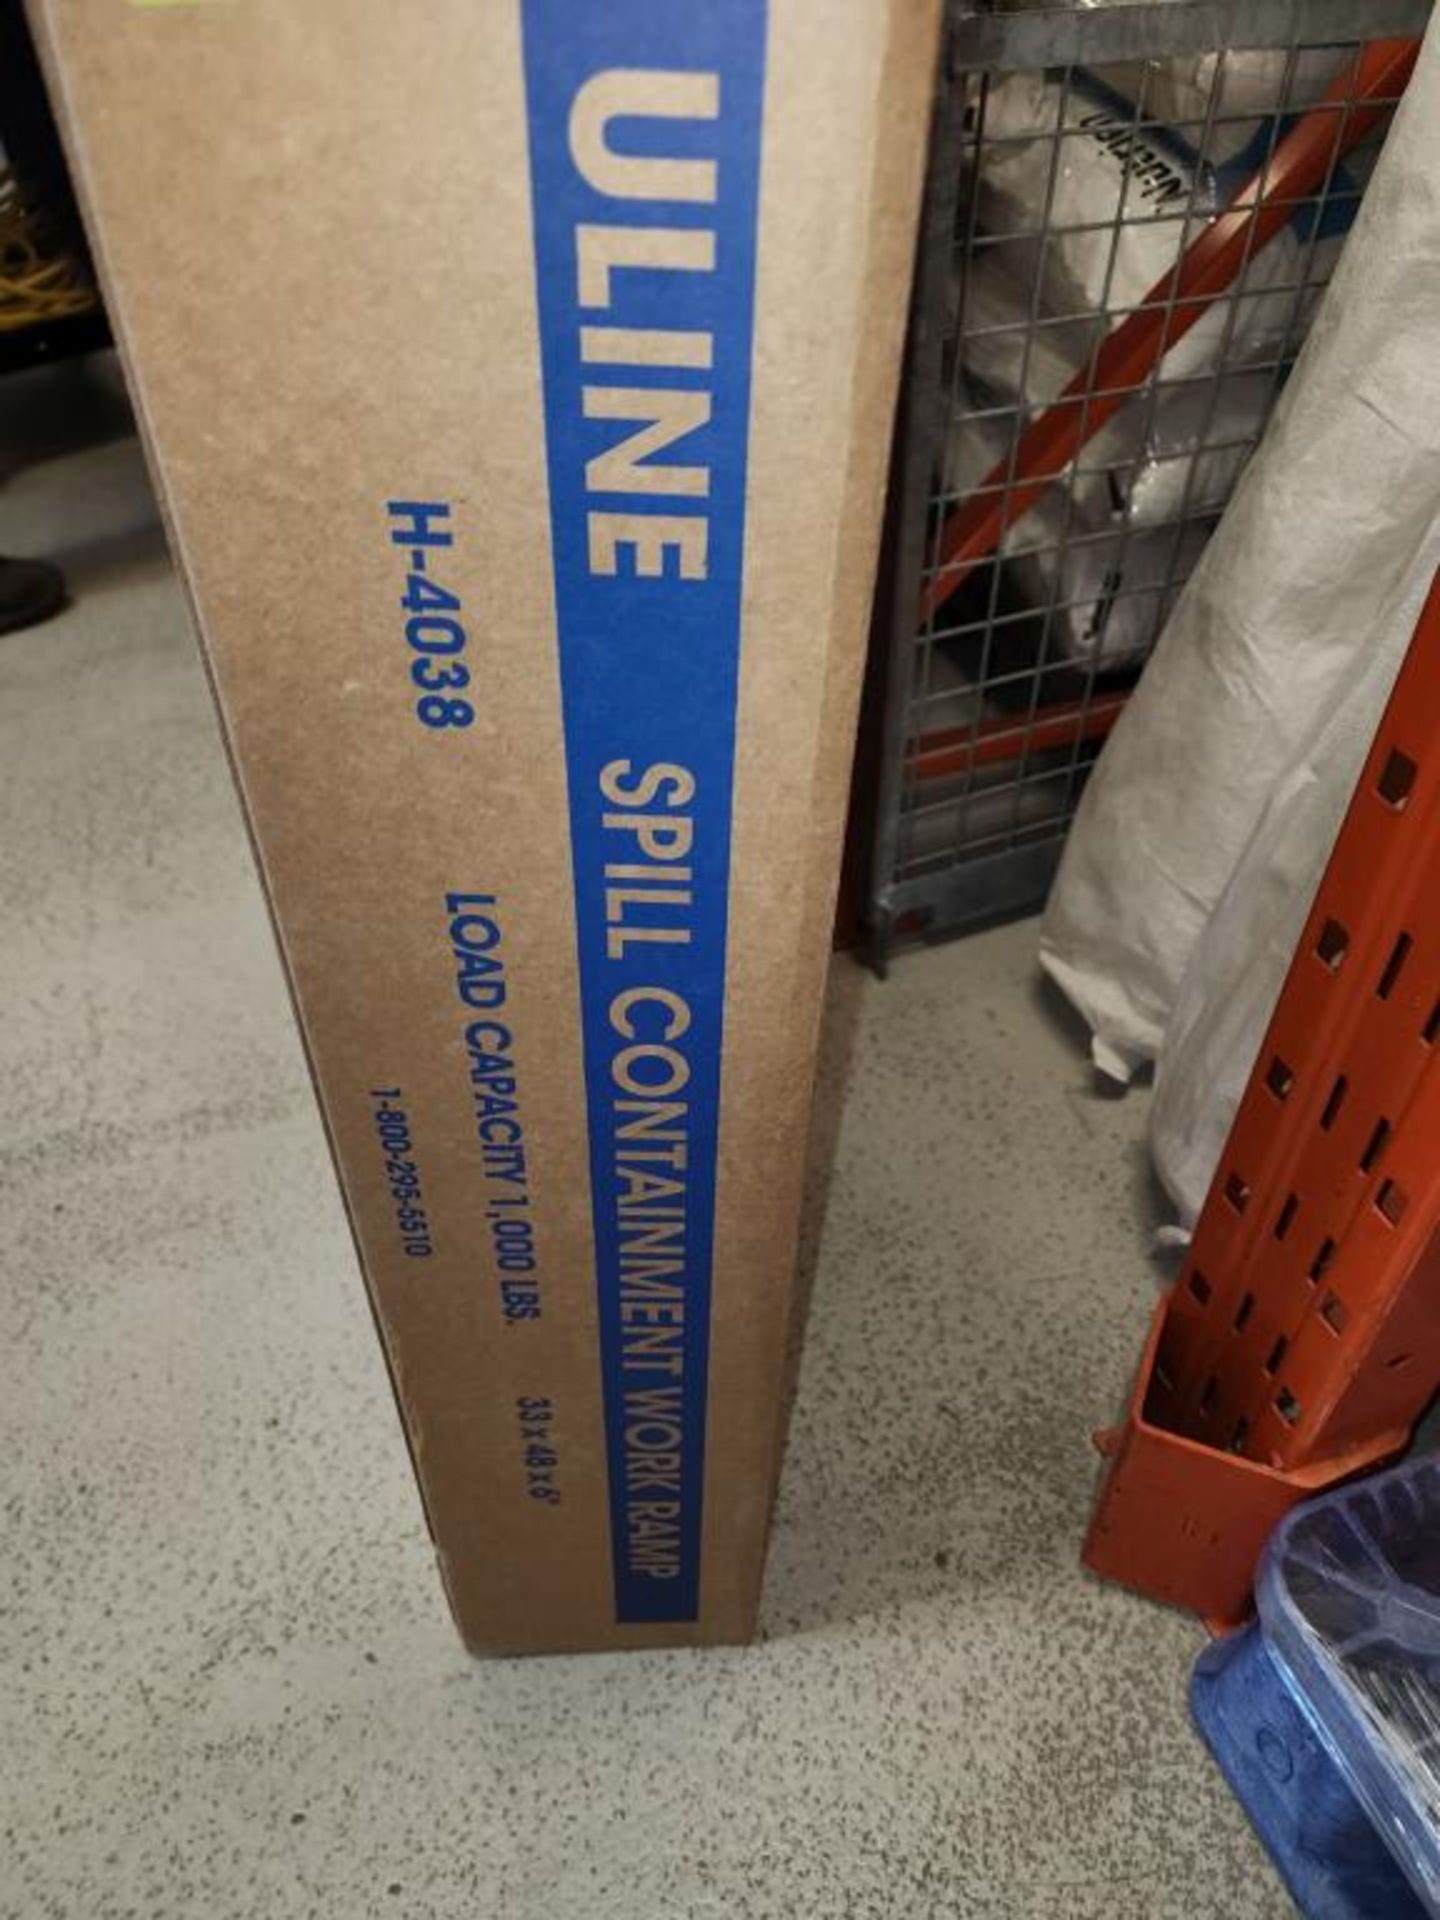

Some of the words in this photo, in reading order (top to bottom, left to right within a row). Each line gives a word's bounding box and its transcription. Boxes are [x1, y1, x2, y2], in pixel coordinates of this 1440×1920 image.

[567, 67, 719, 580] ULINE
[387, 501, 476, 728] H-4038
[600, 758, 696, 960] SPILL
[445, 893, 506, 1010] LOAD
[465, 1020, 526, 1184] CAPACITY
[370, 1087, 432, 1257] 1-800-295-5510
[606, 986, 692, 1375] CONTAINMENT
[484, 1195, 536, 1270] 1,000
[500, 1280, 541, 1325] LBS.
[516, 1397, 552, 1420] 33
[524, 1443, 559, 1467] 48
[622, 1386, 683, 1491] WORK
[627, 1502, 681, 1578] RAMP
